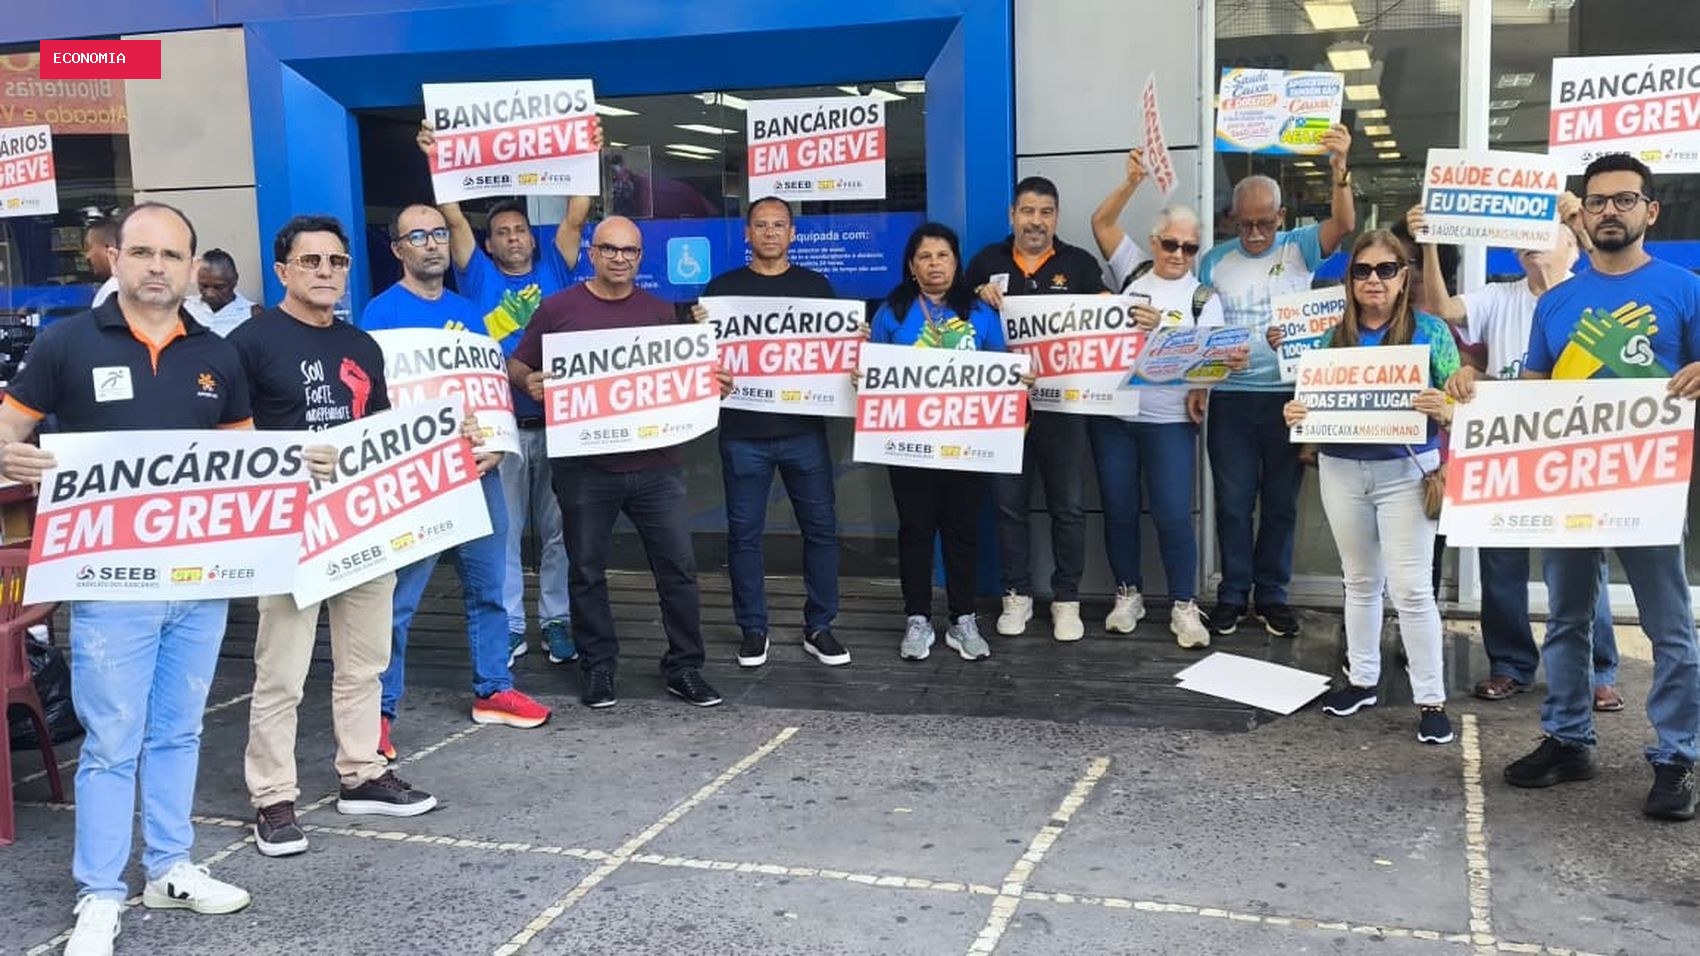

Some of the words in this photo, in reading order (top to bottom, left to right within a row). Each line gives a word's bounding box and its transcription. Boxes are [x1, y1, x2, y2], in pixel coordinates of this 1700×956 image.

[434, 88, 588, 131] BANCÁRIOS
[754, 103, 879, 140] BANCÁRIOS
[1557, 108, 1603, 143] EM
[437, 136, 482, 169] EM
[492, 120, 589, 161] GREVE
[754, 144, 789, 174] EM
[797, 130, 879, 167] GREVE
[476, 174, 511, 186] SEEB
[784, 181, 811, 189] SEEB
[1430, 160, 1494, 186] SAÚDE
[1497, 168, 1558, 190] CAIXA
[1430, 192, 1455, 211] EU
[1457, 194, 1548, 217] DEFENDO!
[842, 229, 869, 240] com:
[709, 305, 860, 340] BANCÁRIOS
[1007, 302, 1138, 341] BANCÁRIOS
[552, 336, 710, 380] BANCÁRIOS
[717, 343, 749, 374] M
[759, 340, 857, 374] GREVE
[1048, 336, 1138, 373] GREVE
[301, 360, 324, 385] SOU
[865, 358, 1022, 390] BANCÁRIOS
[1302, 362, 1358, 386] SAÚDE
[1363, 364, 1422, 385] CAIXA
[305, 385, 335, 406] FORTE
[440, 378, 513, 411] GREV
[553, 383, 598, 422] EM
[609, 365, 712, 412] GREVE
[743, 388, 773, 399] SEEB
[1040, 388, 1060, 398] SEEB
[1337, 393, 1358, 408] EM
[862, 396, 906, 429] EM
[917, 394, 1019, 428] GREVE
[1465, 394, 1682, 449] BANCÁRIOS
[594, 428, 629, 440] SEEB
[1295, 423, 1420, 437] #SAÚDECAIXAMAISHUMANO
[898, 441, 932, 453] SEEB
[51, 442, 304, 503] BANCÁRIOS
[1462, 457, 1519, 501] EM
[1535, 436, 1679, 493] GREVE
[302, 503, 339, 555] M
[345, 444, 467, 526] GREVE
[41, 504, 114, 557] EM
[134, 487, 297, 543] GREVE
[1508, 514, 1553, 527] SEEB
[100, 567, 157, 580] SEEB
[221, 568, 255, 579] FEEB
[341, 545, 383, 570] SEEB
